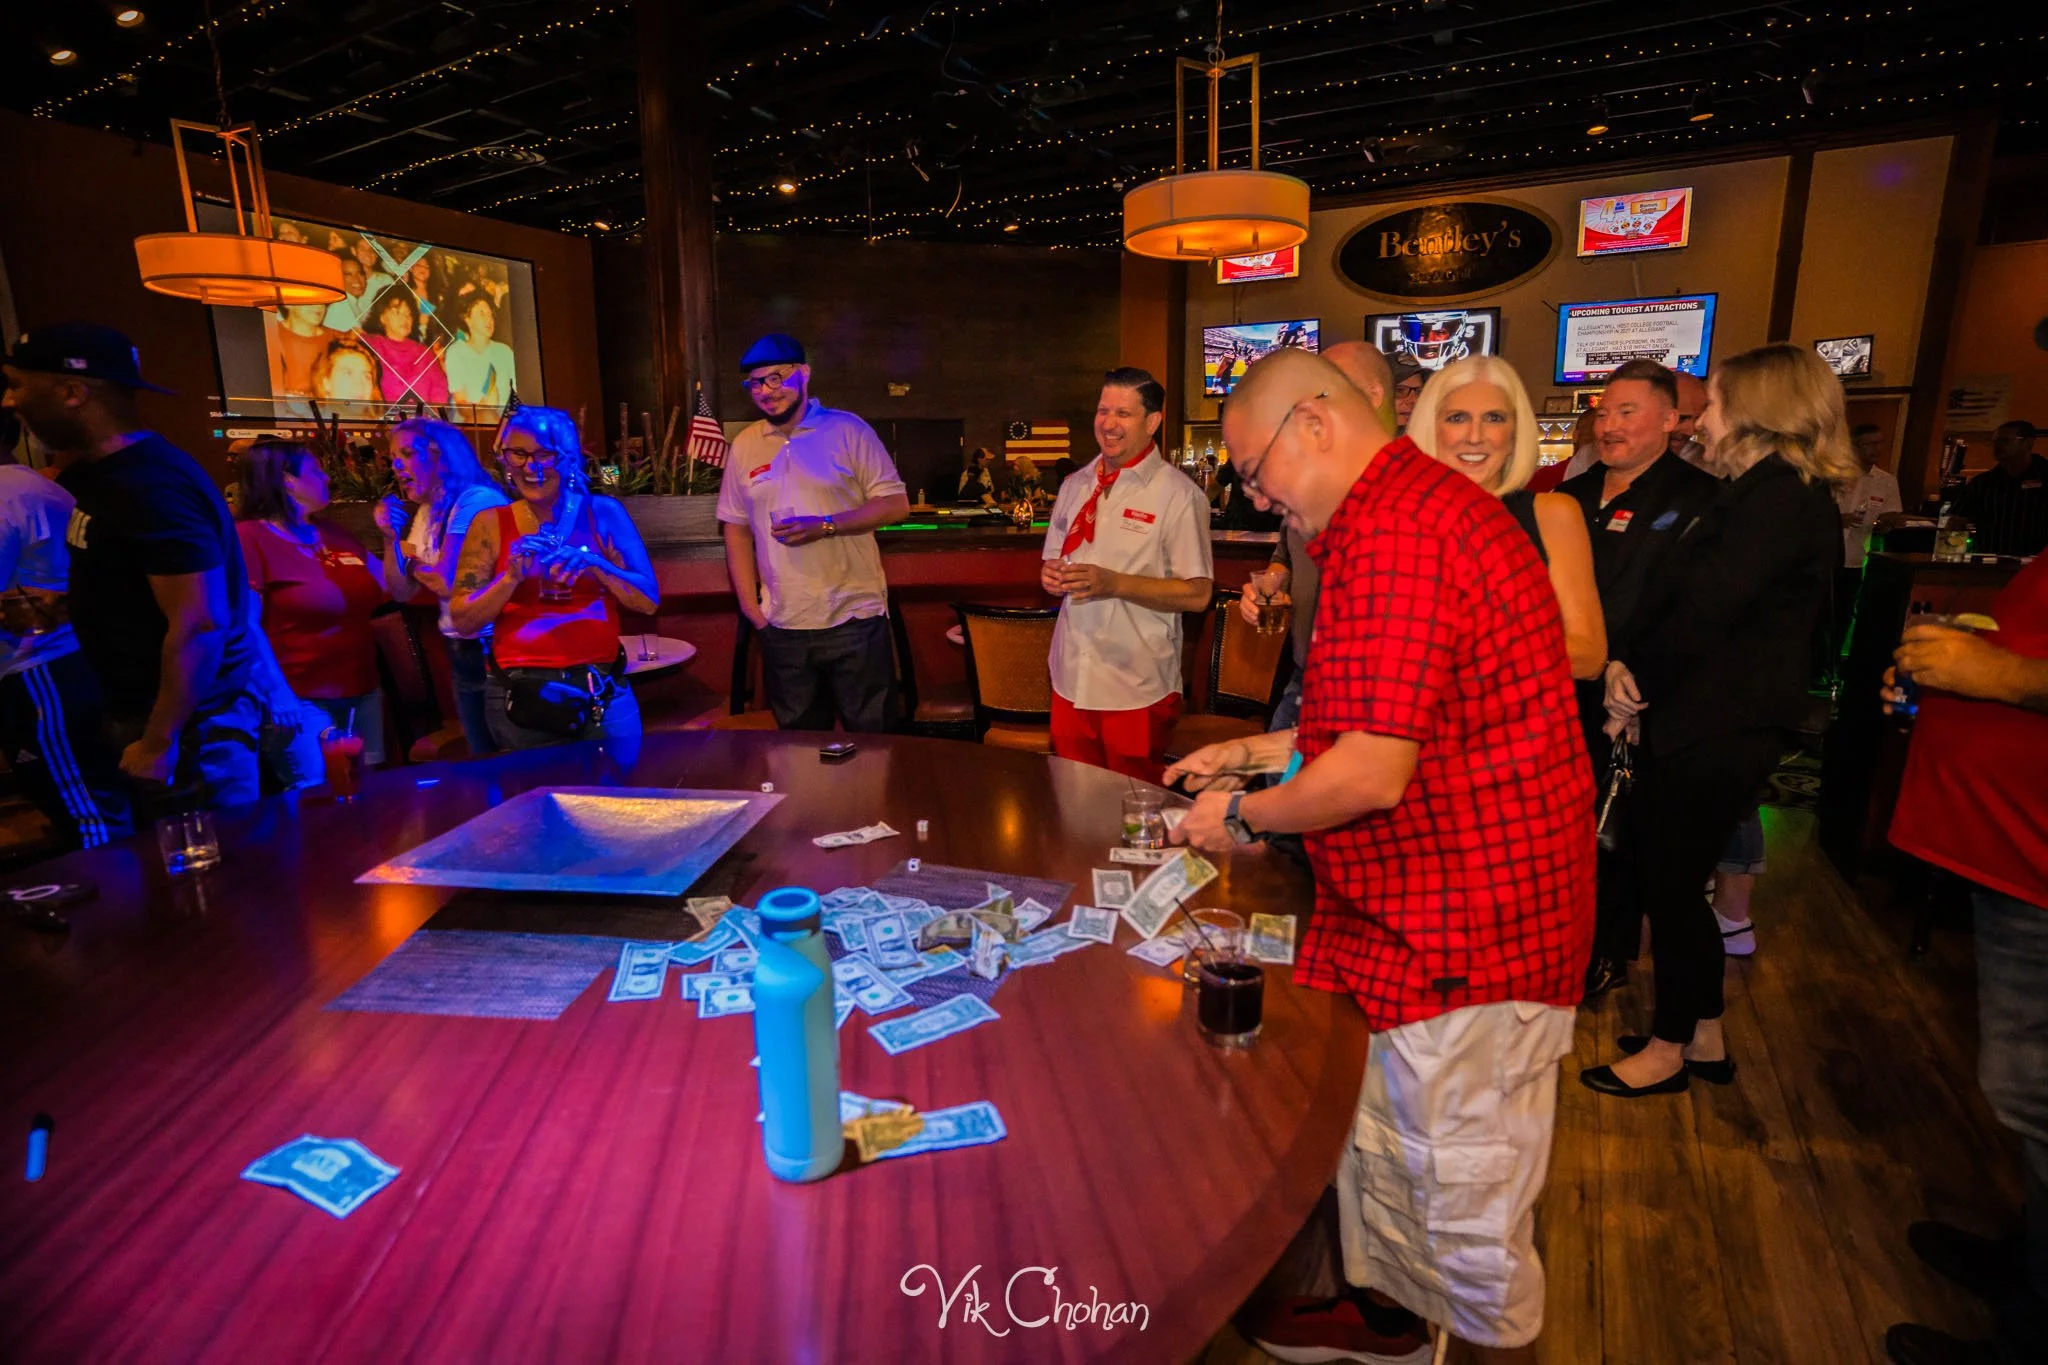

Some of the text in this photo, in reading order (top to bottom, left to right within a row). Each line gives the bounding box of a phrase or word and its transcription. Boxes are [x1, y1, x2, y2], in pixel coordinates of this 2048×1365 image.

[1378, 220, 1522, 259] Bentley's
[1571, 302, 1698, 317] UPCOMING TOURIST ATTRACTIONS
